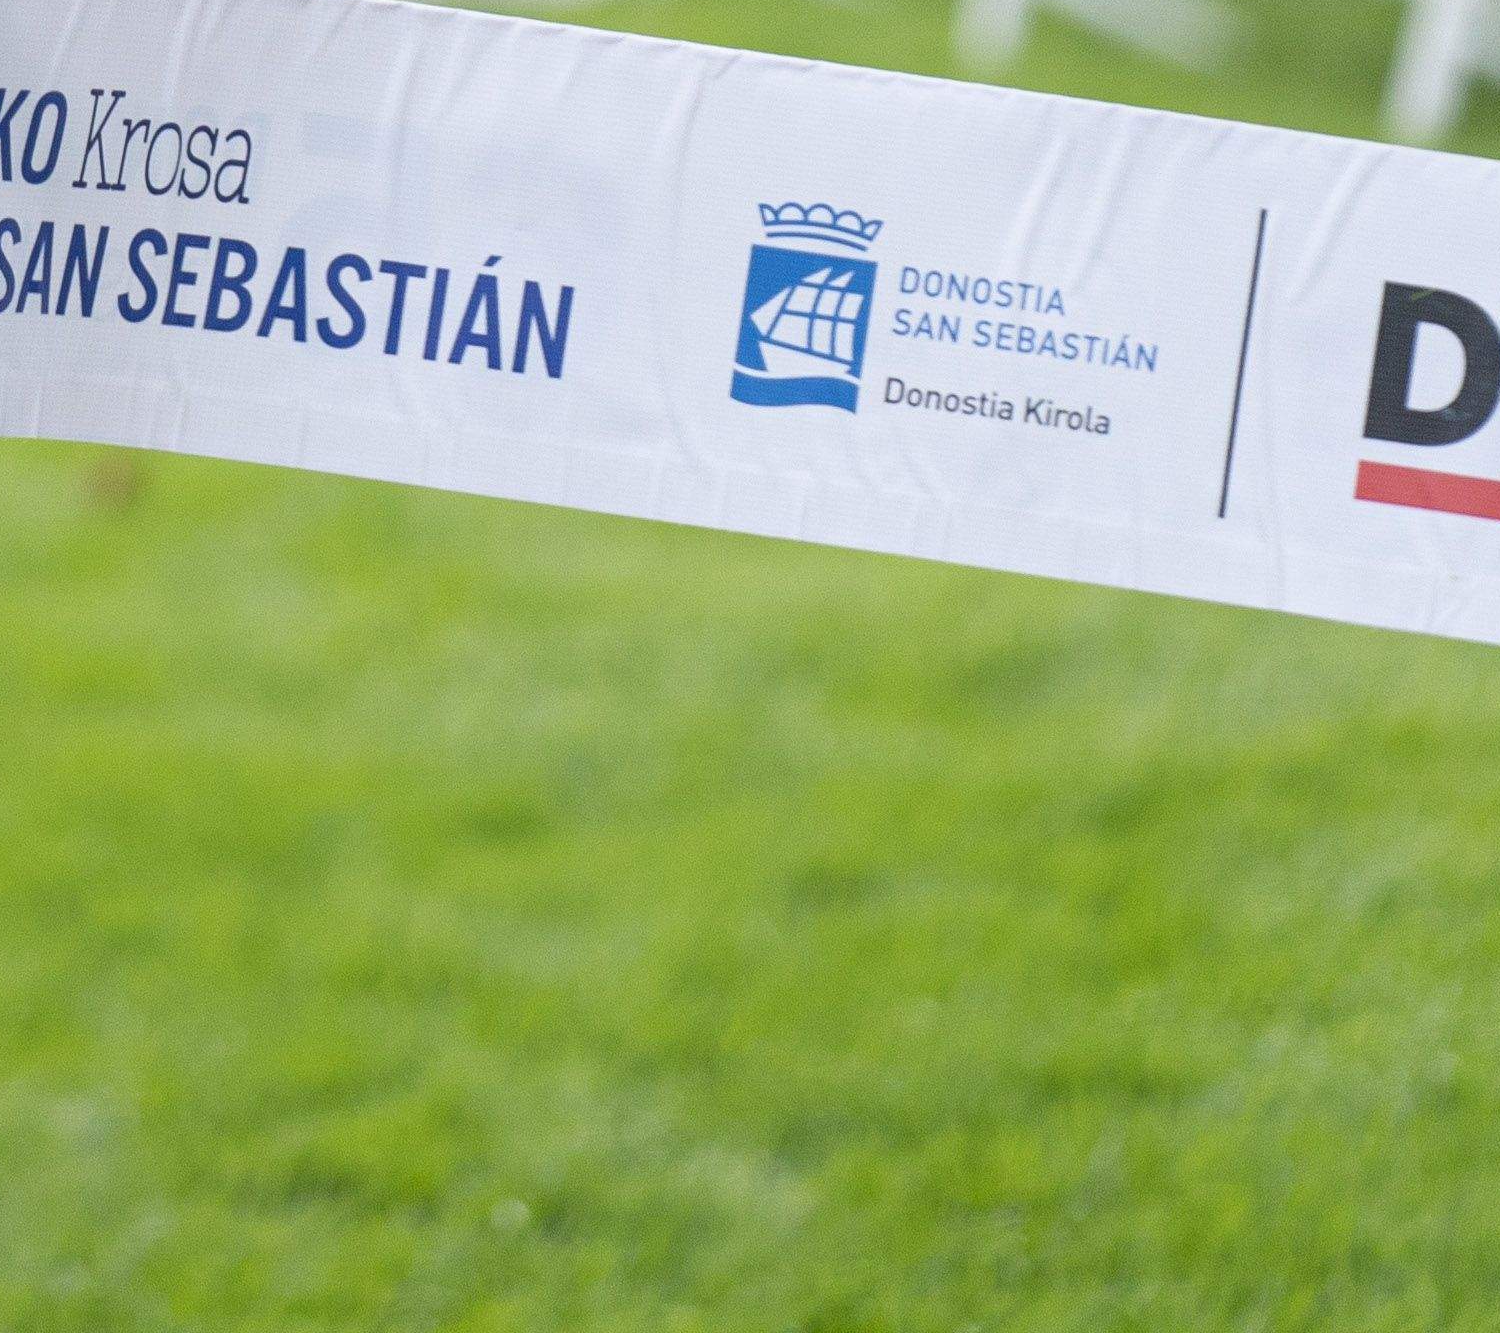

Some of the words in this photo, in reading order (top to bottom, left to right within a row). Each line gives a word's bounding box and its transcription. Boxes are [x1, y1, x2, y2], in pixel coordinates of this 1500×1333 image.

[70, 88, 253, 205] Krosa
[116, 228, 575, 381] SEBASTIÁN
[900, 265, 1065, 315] DONOSTIA
[892, 308, 961, 343] SAN
[971, 316, 1158, 372] SEBASTIÁN
[884, 376, 1014, 422] Donostia
[1023, 397, 1111, 436] Kirola
